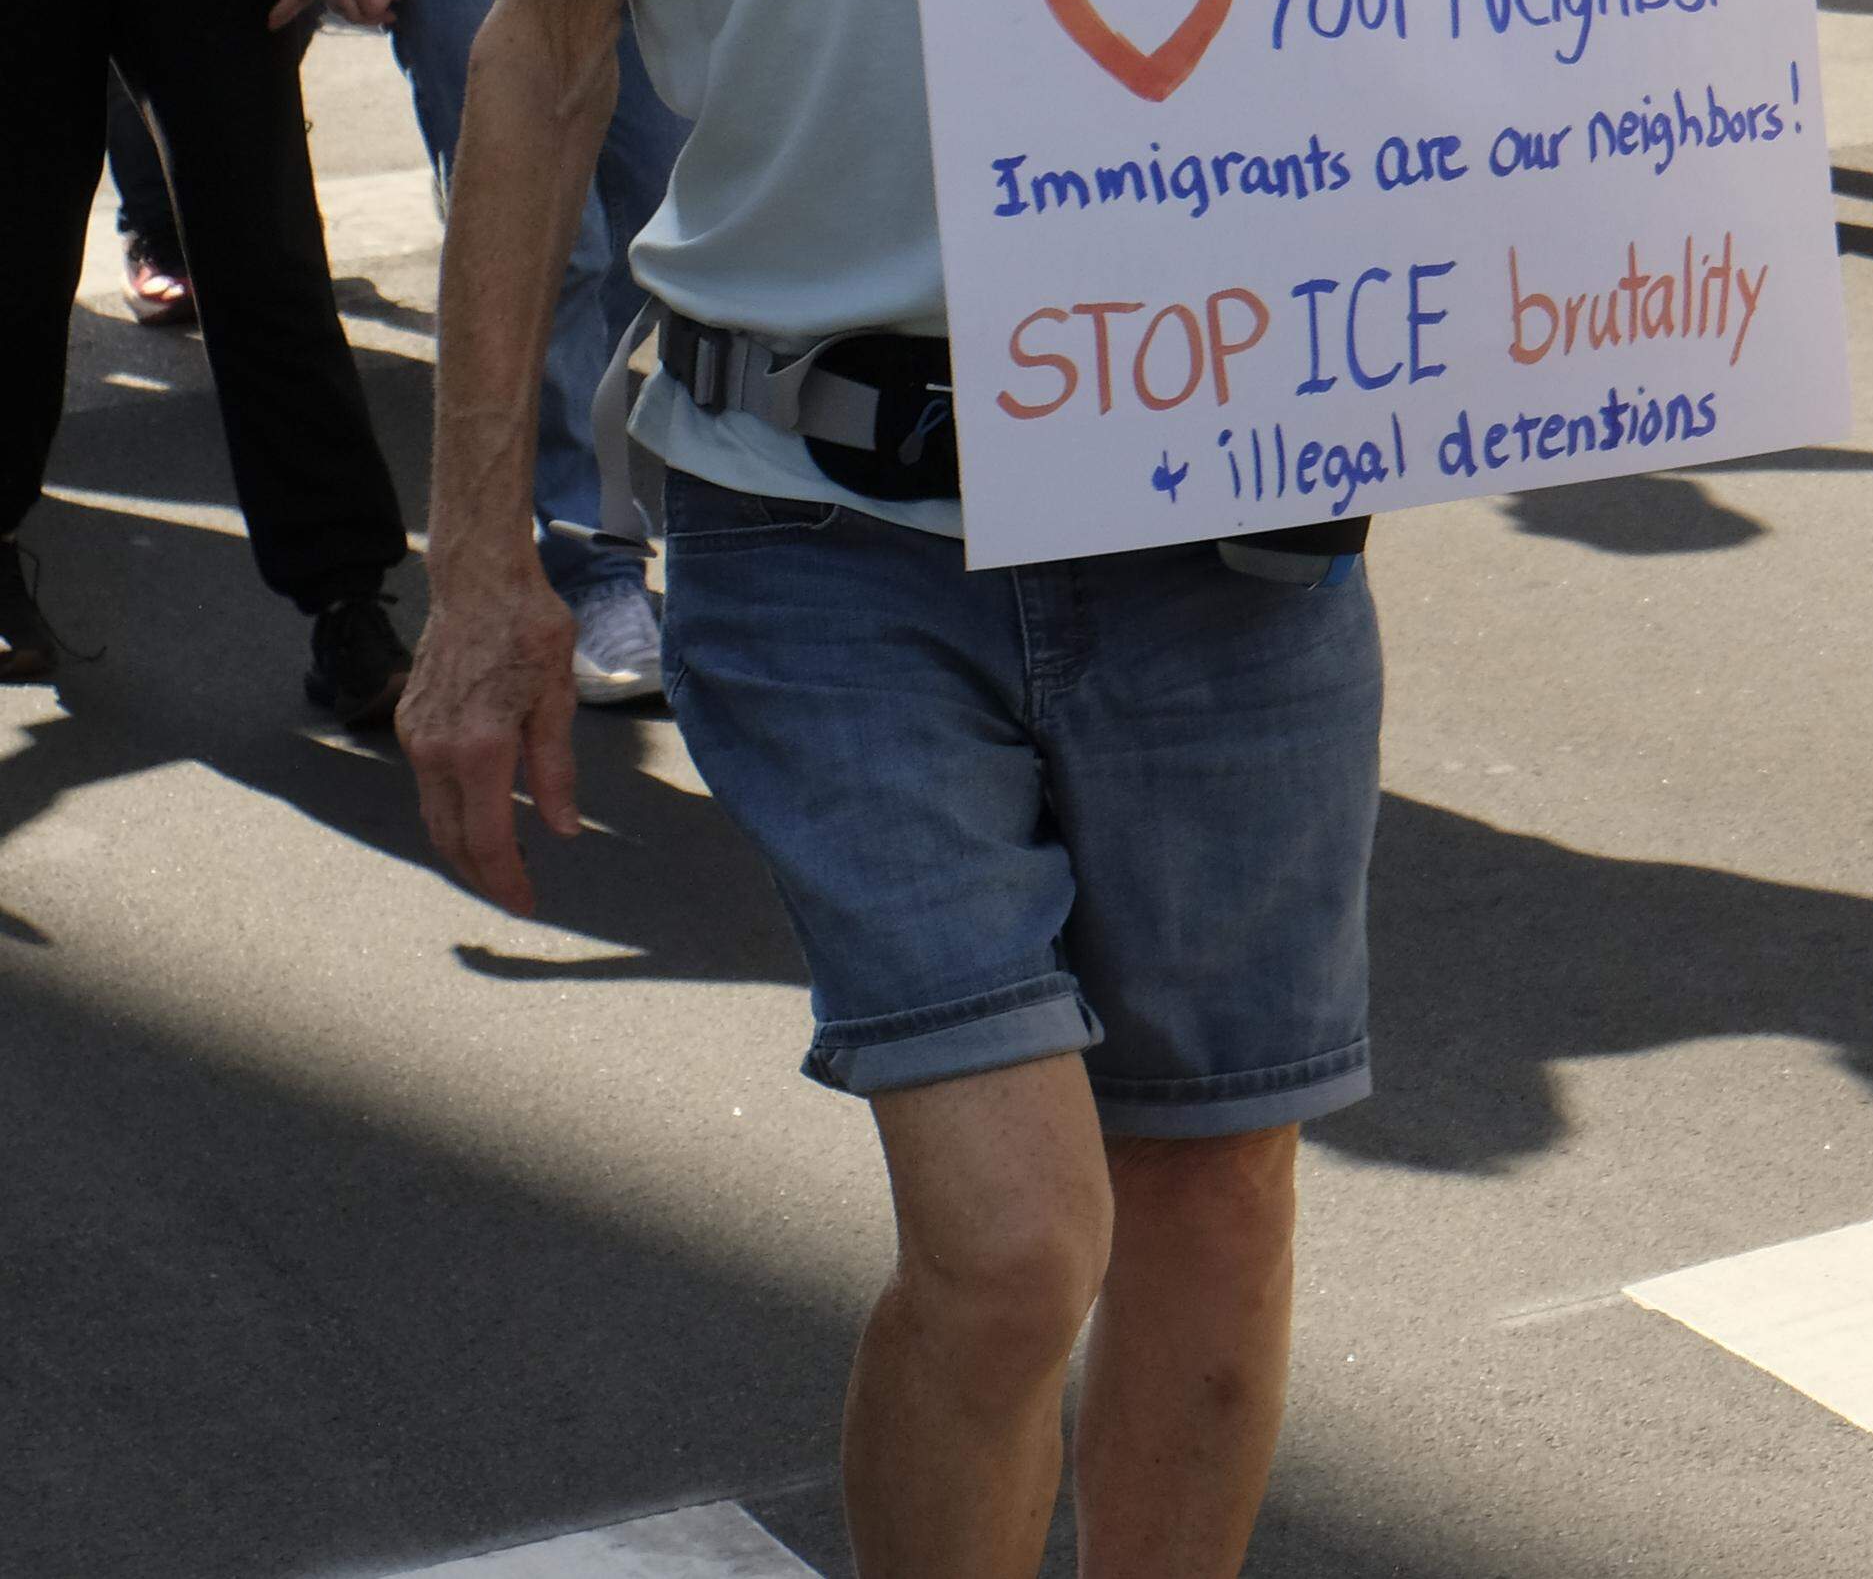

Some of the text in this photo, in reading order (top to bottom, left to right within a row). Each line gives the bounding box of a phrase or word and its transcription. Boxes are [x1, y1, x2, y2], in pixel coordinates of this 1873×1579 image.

[993, 60, 1804, 218] Immigrants are our neighbors!
[996, 229, 1770, 421] STOP ICE brutality
[1217, 411, 1407, 517] illegal
[1438, 387, 1717, 479] detentions
